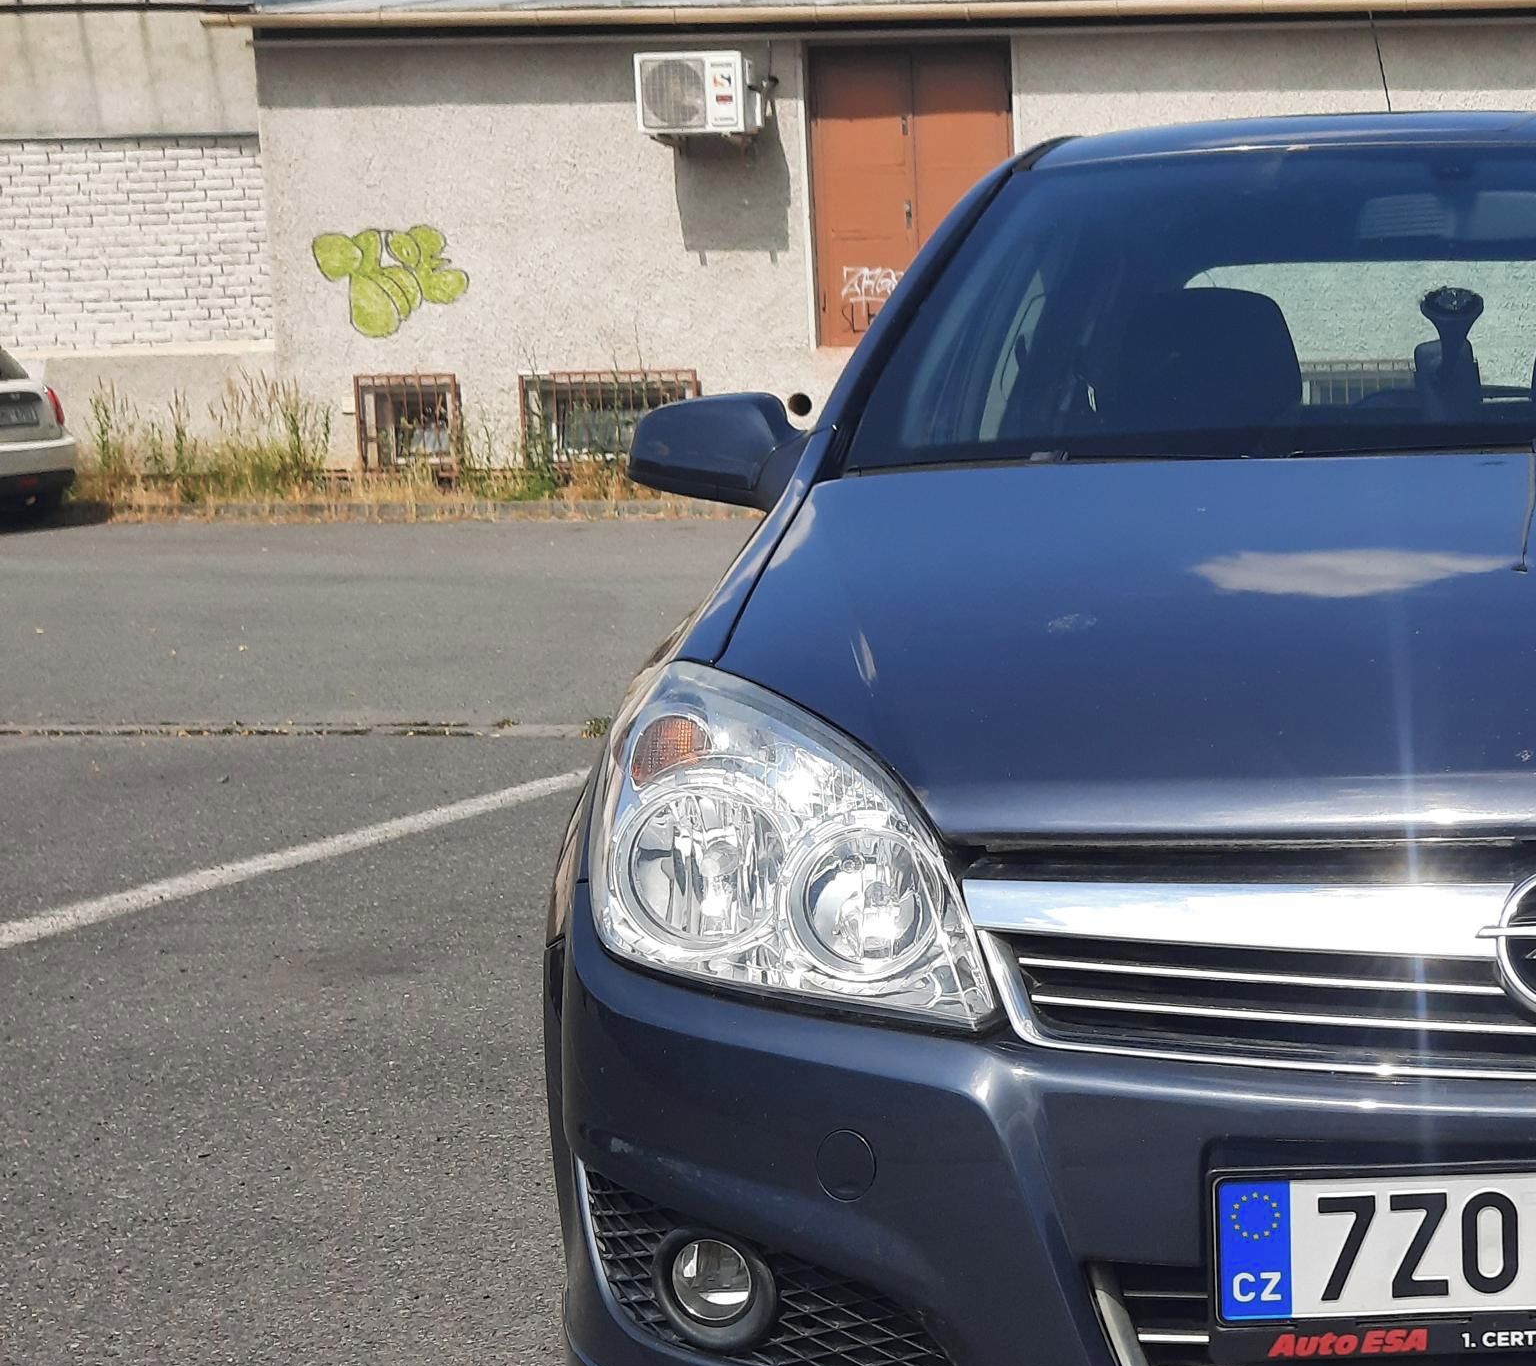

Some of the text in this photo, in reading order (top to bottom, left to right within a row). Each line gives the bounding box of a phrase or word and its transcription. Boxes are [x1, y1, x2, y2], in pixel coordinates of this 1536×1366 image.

[1317, 1190, 1519, 1301] 7Z0
[1232, 1272, 1282, 1302] CZ
[1267, 1329, 1428, 1358] Auto ESA
[1461, 1332, 1477, 1348] 1.
